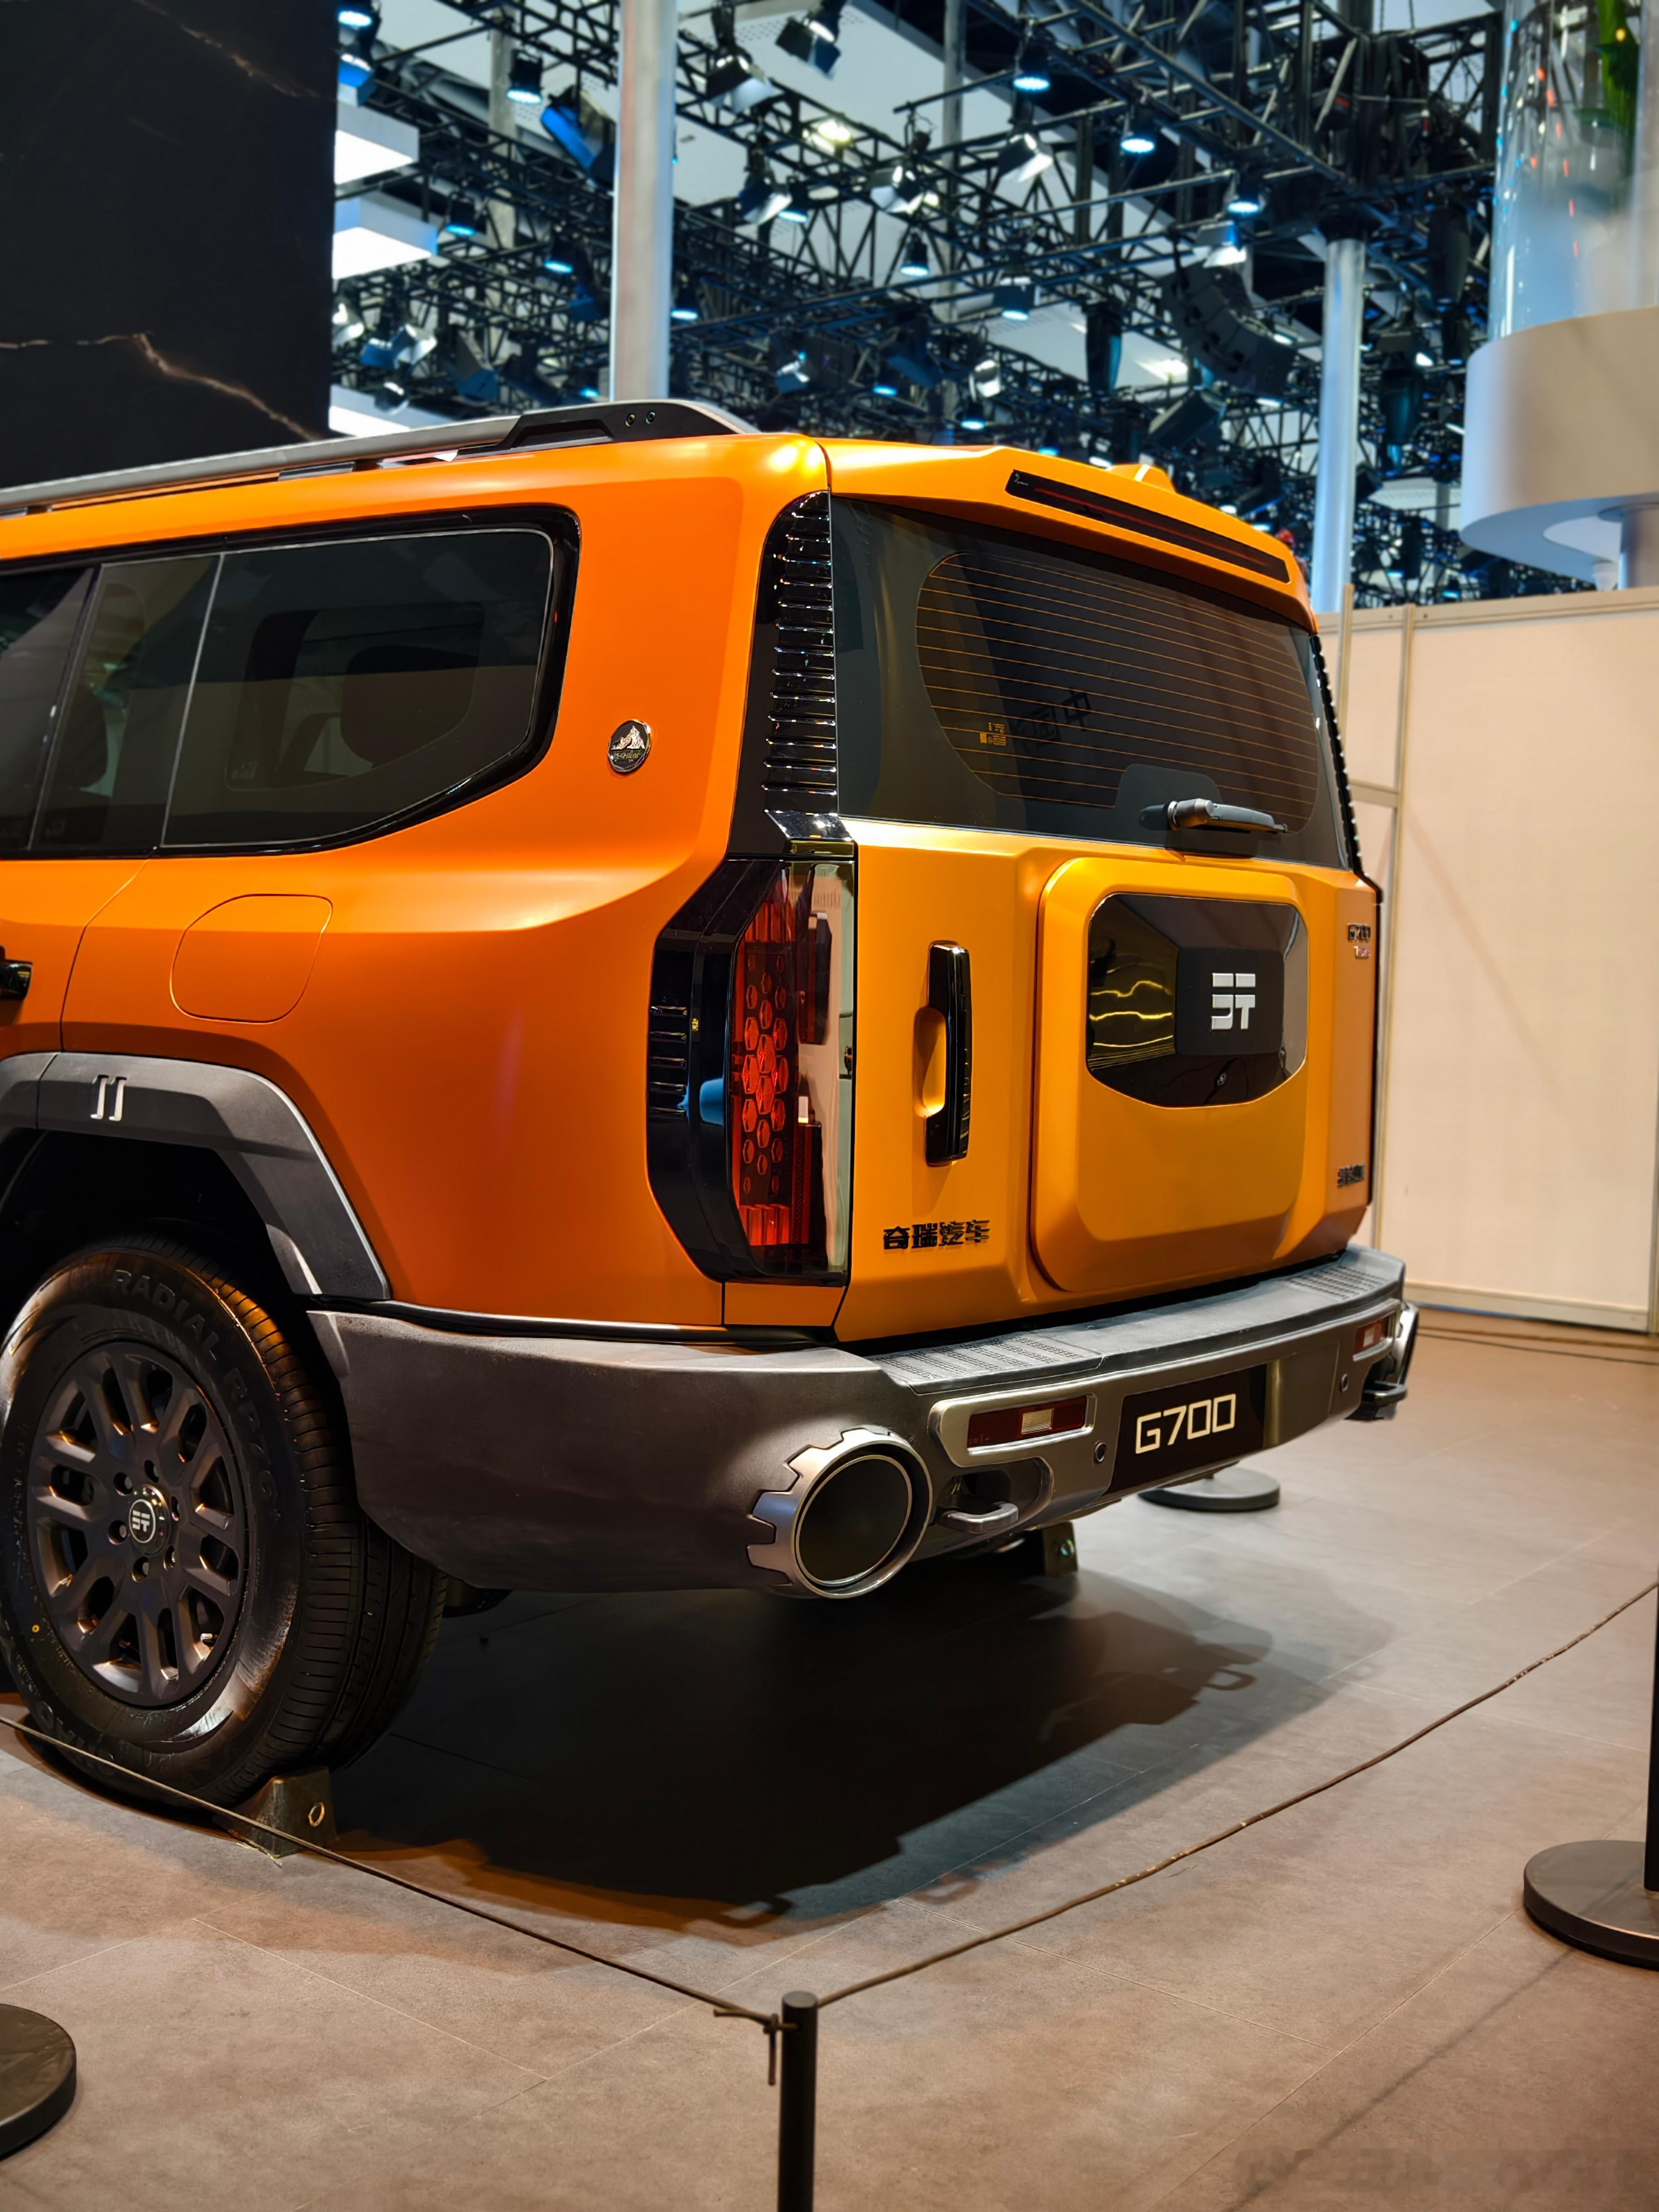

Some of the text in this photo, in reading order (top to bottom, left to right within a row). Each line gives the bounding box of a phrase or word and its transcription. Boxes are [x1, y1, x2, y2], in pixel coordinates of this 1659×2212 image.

[884, 1219, 990, 1250] 奇瑞汽车
[114, 1269, 220, 1361] RADIAL
[1136, 1393, 1236, 1454] G700
